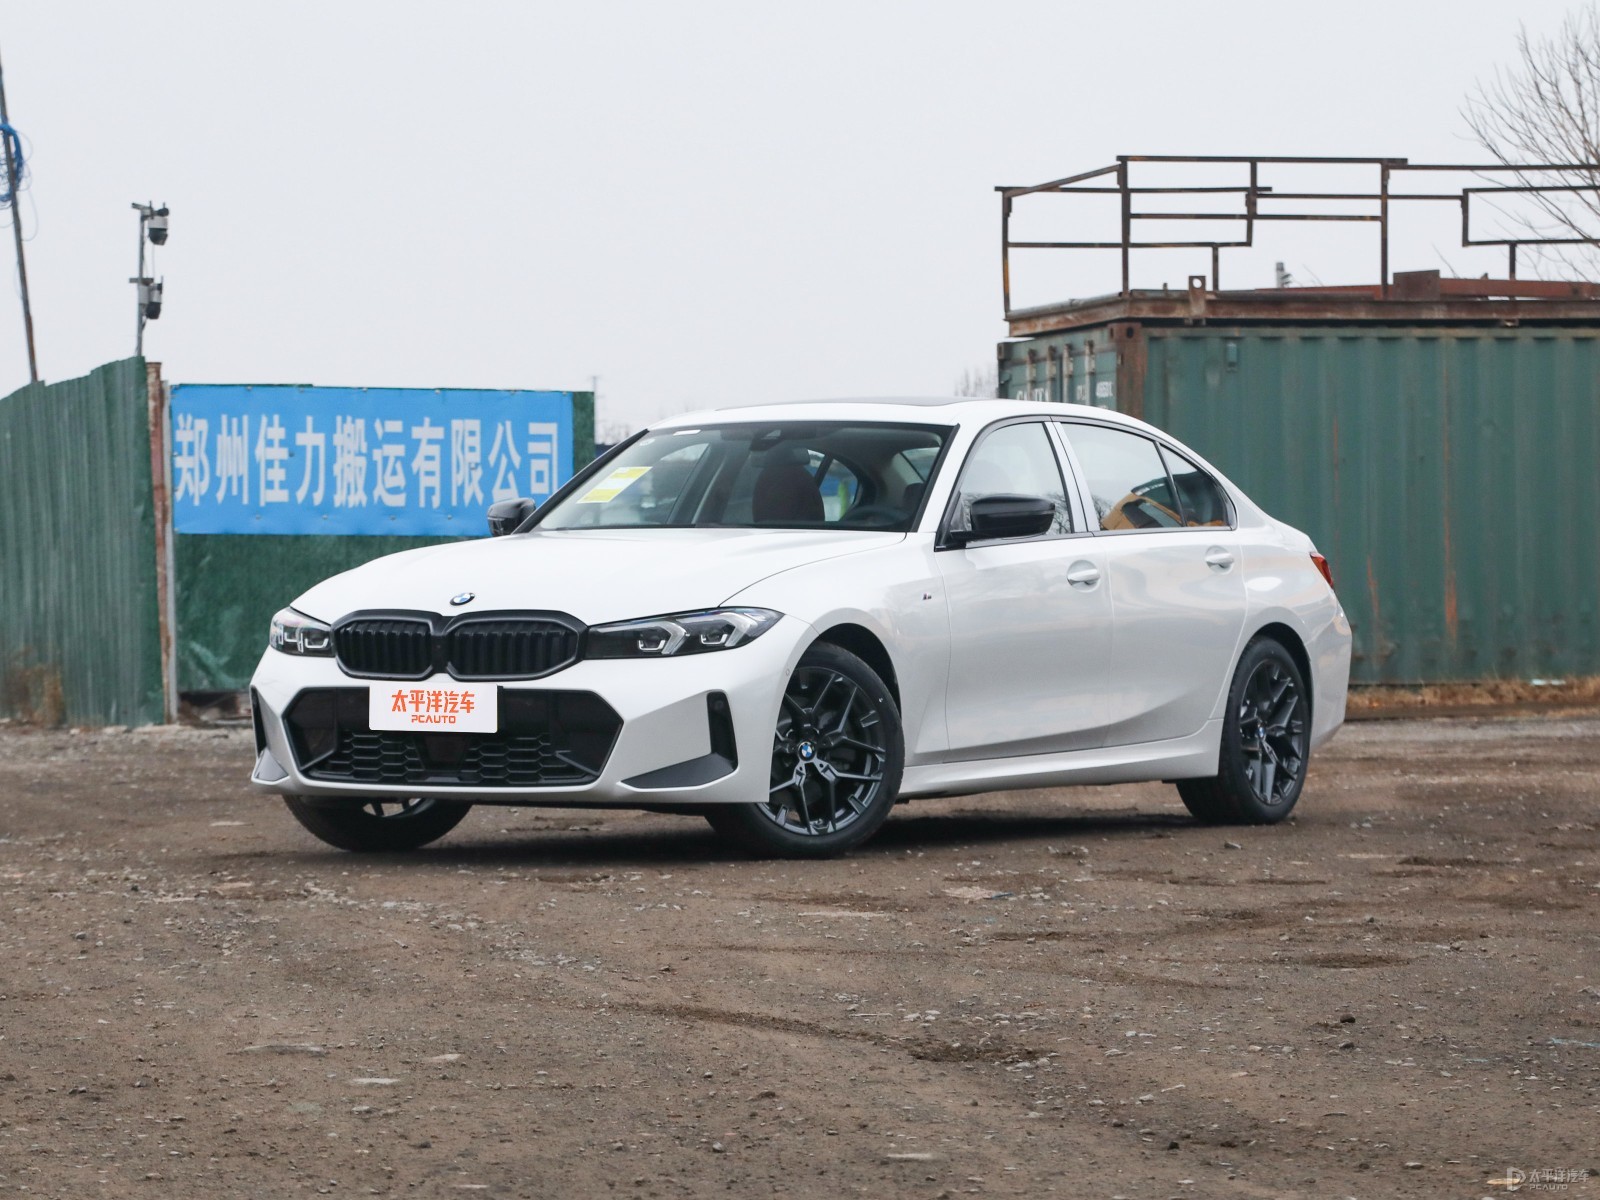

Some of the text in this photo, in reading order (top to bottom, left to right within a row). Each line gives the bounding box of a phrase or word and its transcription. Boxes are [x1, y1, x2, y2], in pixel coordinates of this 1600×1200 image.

[174, 413, 559, 508] 郑州佳力搬运有限公司
[391, 689, 475, 713] 太平洋汽车
[411, 714, 456, 724] PCAUTO
